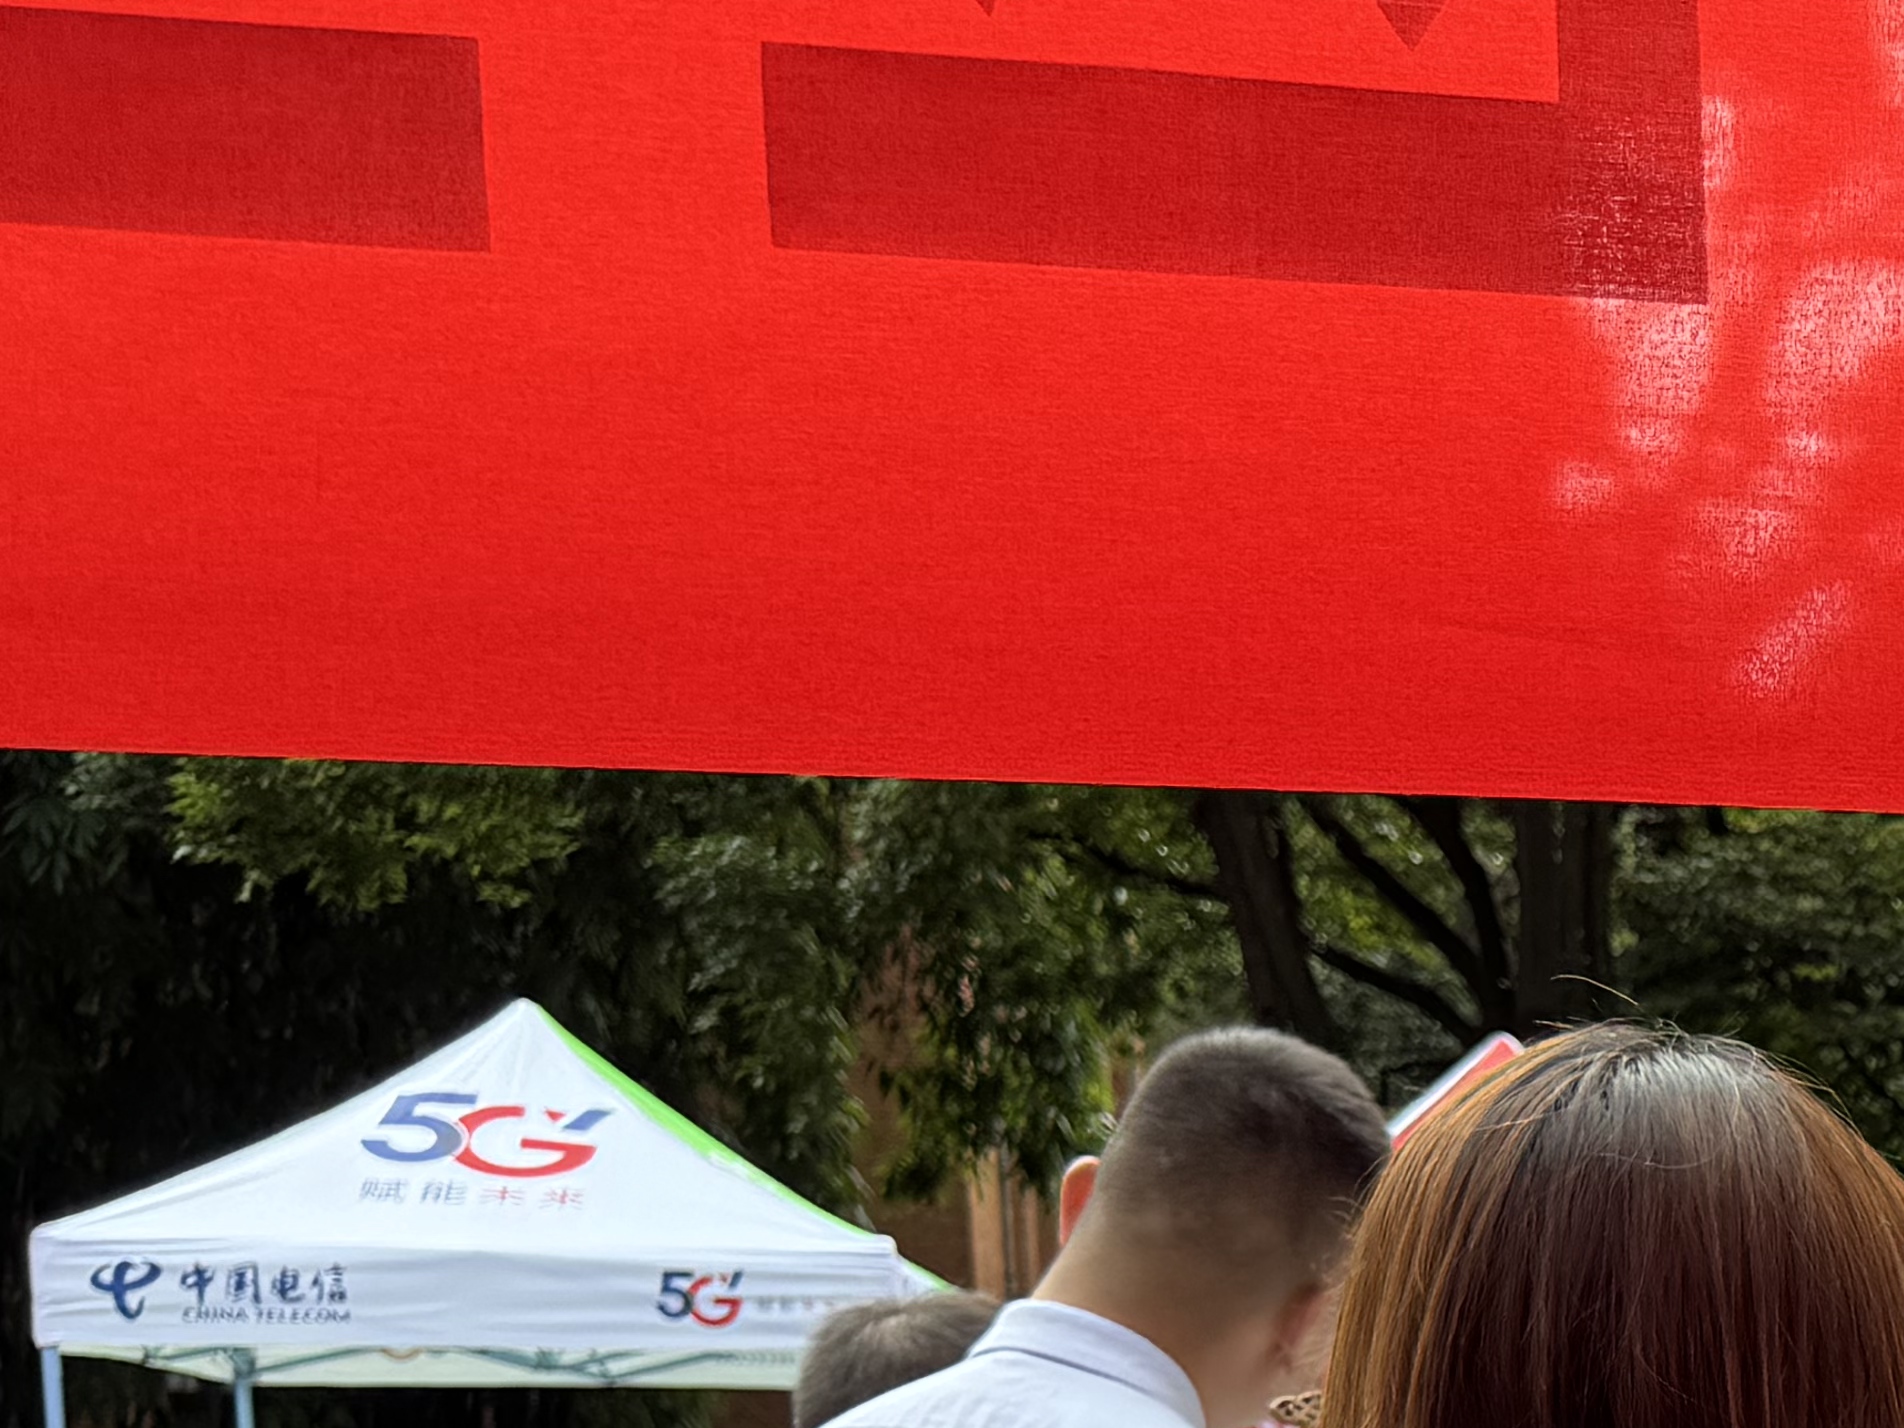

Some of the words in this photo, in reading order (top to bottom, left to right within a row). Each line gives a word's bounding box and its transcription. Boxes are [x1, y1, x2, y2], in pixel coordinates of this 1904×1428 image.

[361, 1092, 610, 1177] 5G
[180, 1260, 348, 1304] 中国电信
[657, 1270, 744, 1329] 5G
[182, 1306, 248, 1324] CHINA
[255, 1306, 351, 1325] TELECOM
